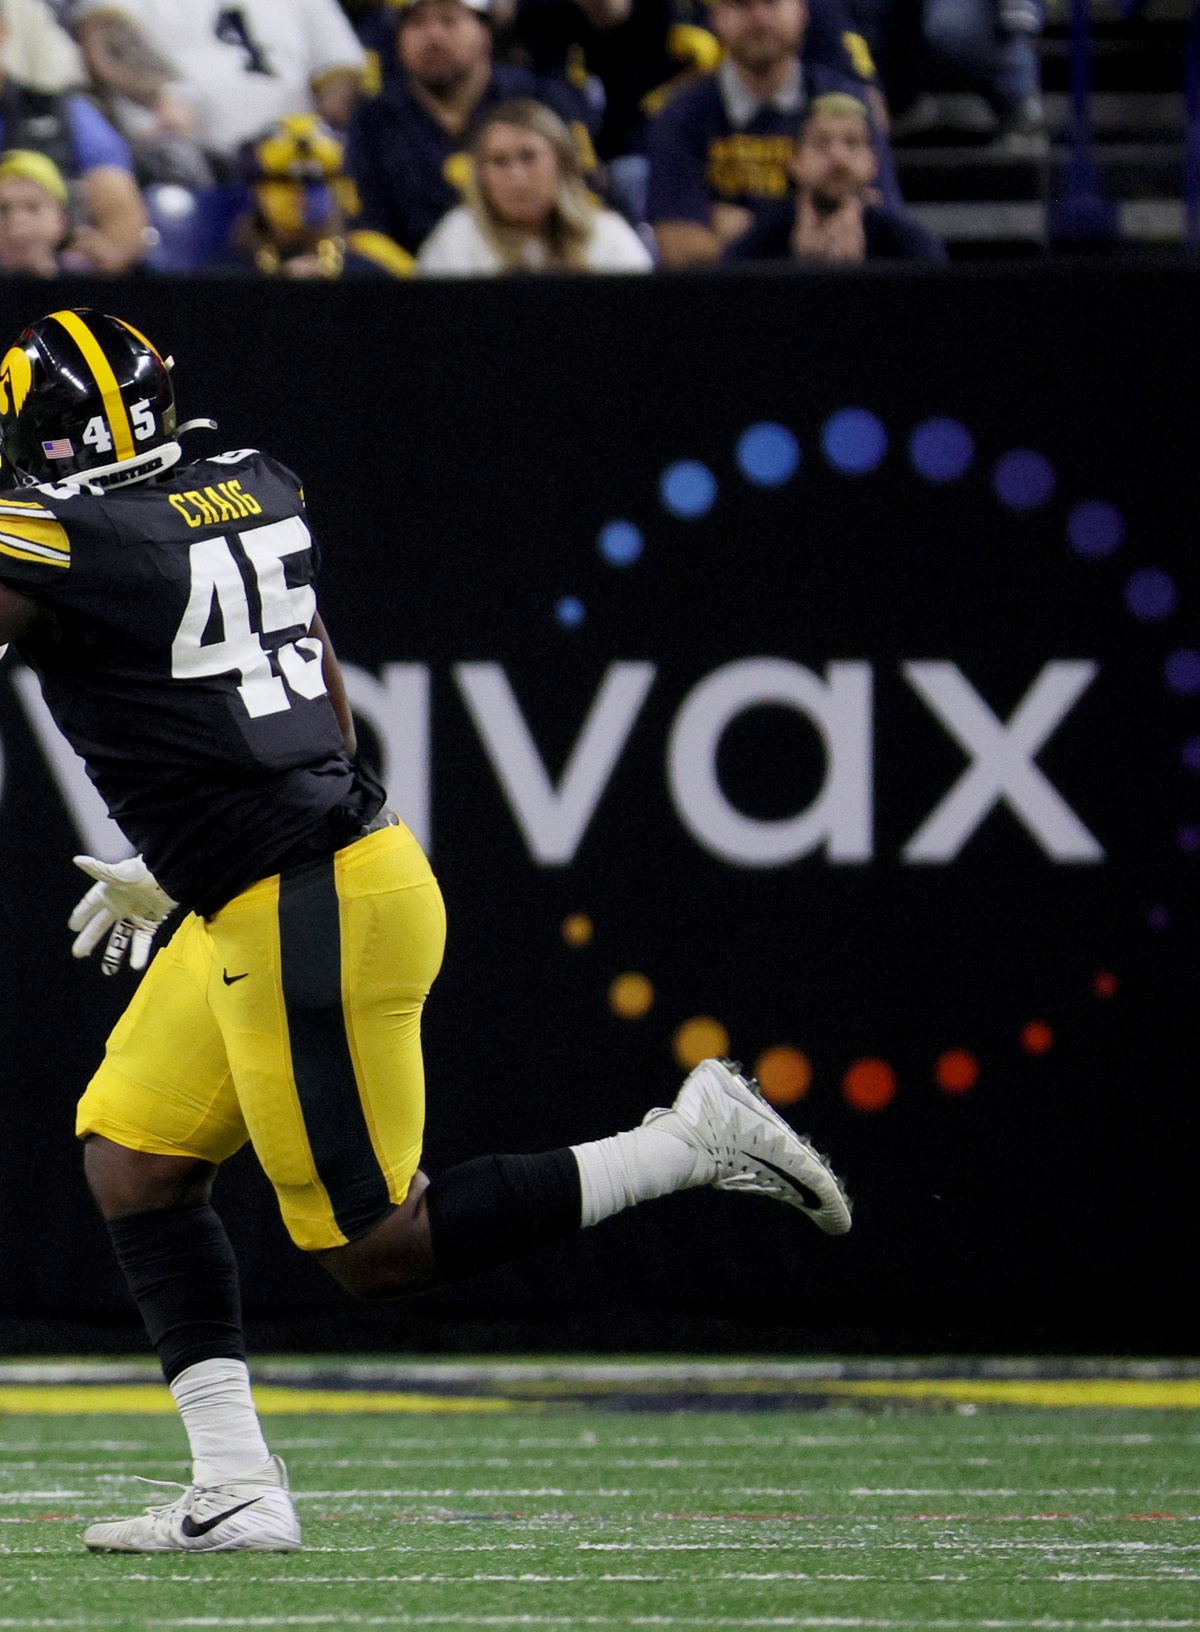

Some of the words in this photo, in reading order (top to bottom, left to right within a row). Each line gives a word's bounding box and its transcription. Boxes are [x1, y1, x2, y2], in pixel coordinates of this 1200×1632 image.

[82, 399, 156, 454] 45
[168, 479, 263, 529] CRAIG
[171, 515, 328, 719] 45
